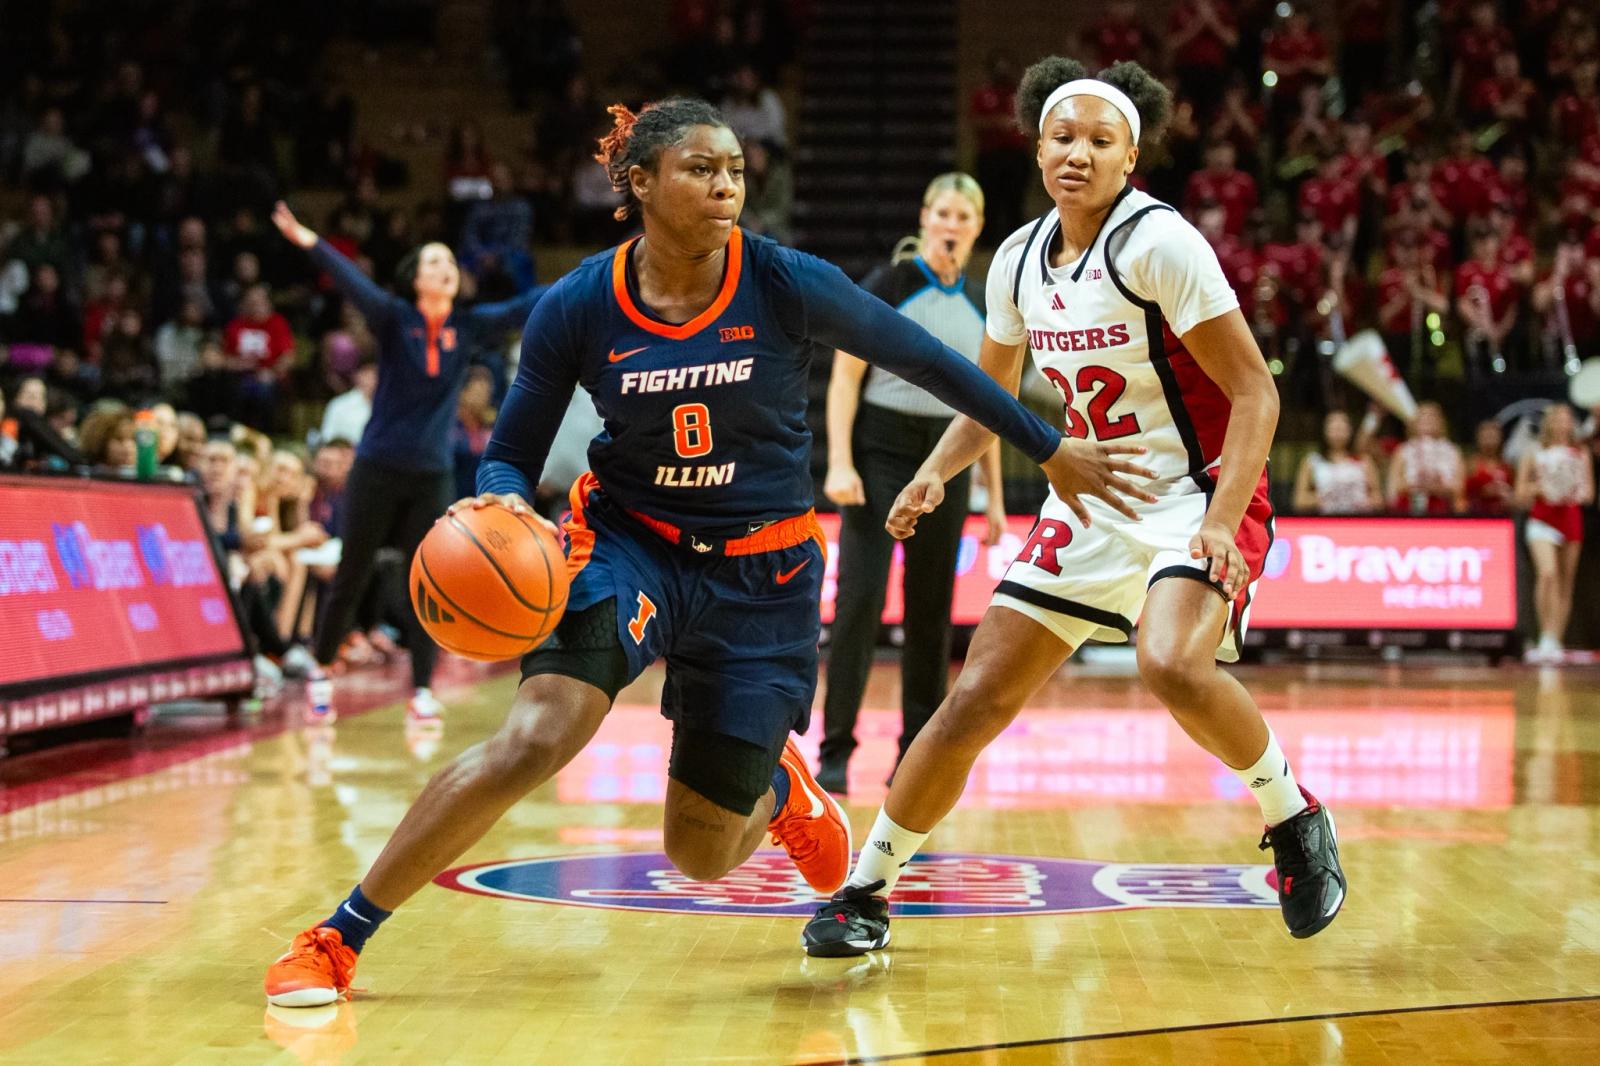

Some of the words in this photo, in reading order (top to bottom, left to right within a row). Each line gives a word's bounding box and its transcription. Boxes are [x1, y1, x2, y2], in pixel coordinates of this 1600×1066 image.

[621, 358, 753, 394] FIGHTING
[672, 402, 713, 458] 8
[654, 462, 735, 487] ILLINI
[1298, 535, 1482, 583] Braven
